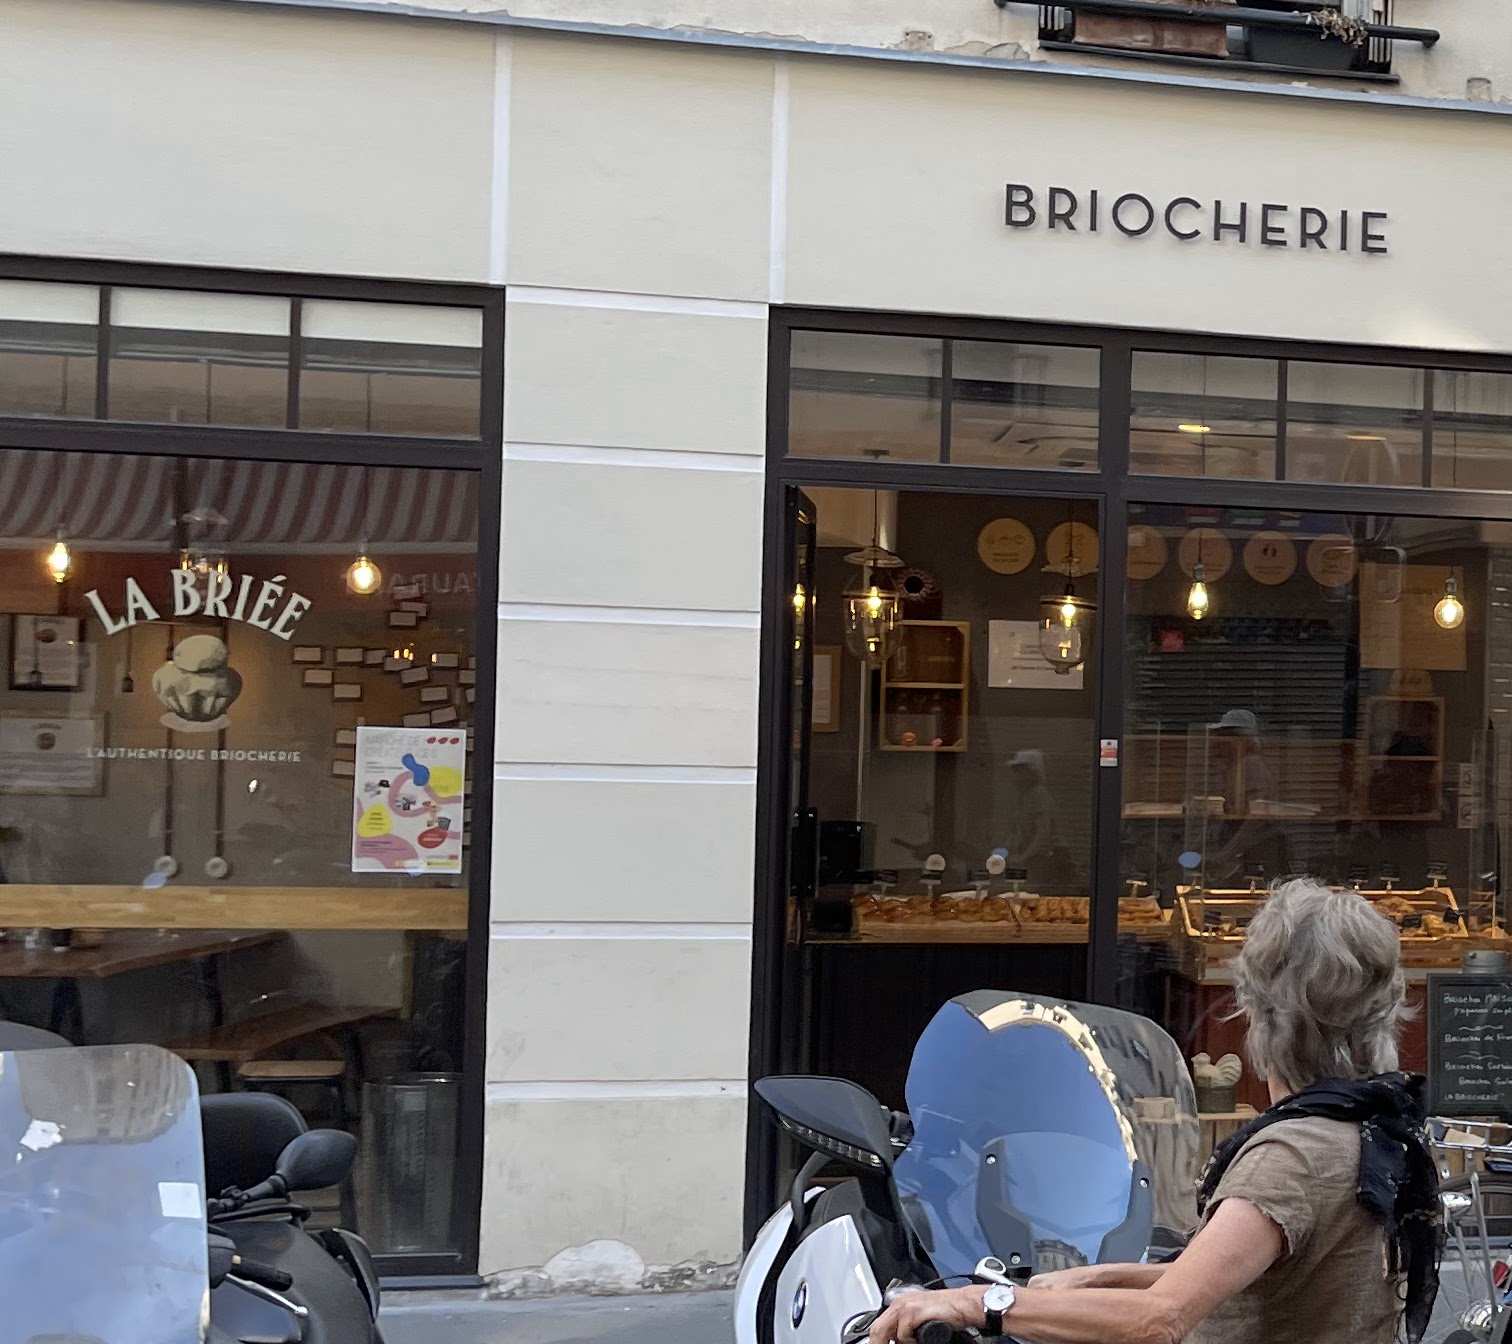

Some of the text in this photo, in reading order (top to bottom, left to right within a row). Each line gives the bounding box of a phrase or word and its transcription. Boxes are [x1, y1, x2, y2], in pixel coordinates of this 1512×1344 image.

[1004, 183, 1388, 254] BRIOCHERIE
[84, 568, 312, 641] LA BRIÉE
[209, 749, 301, 763] BRIOCHERIE
